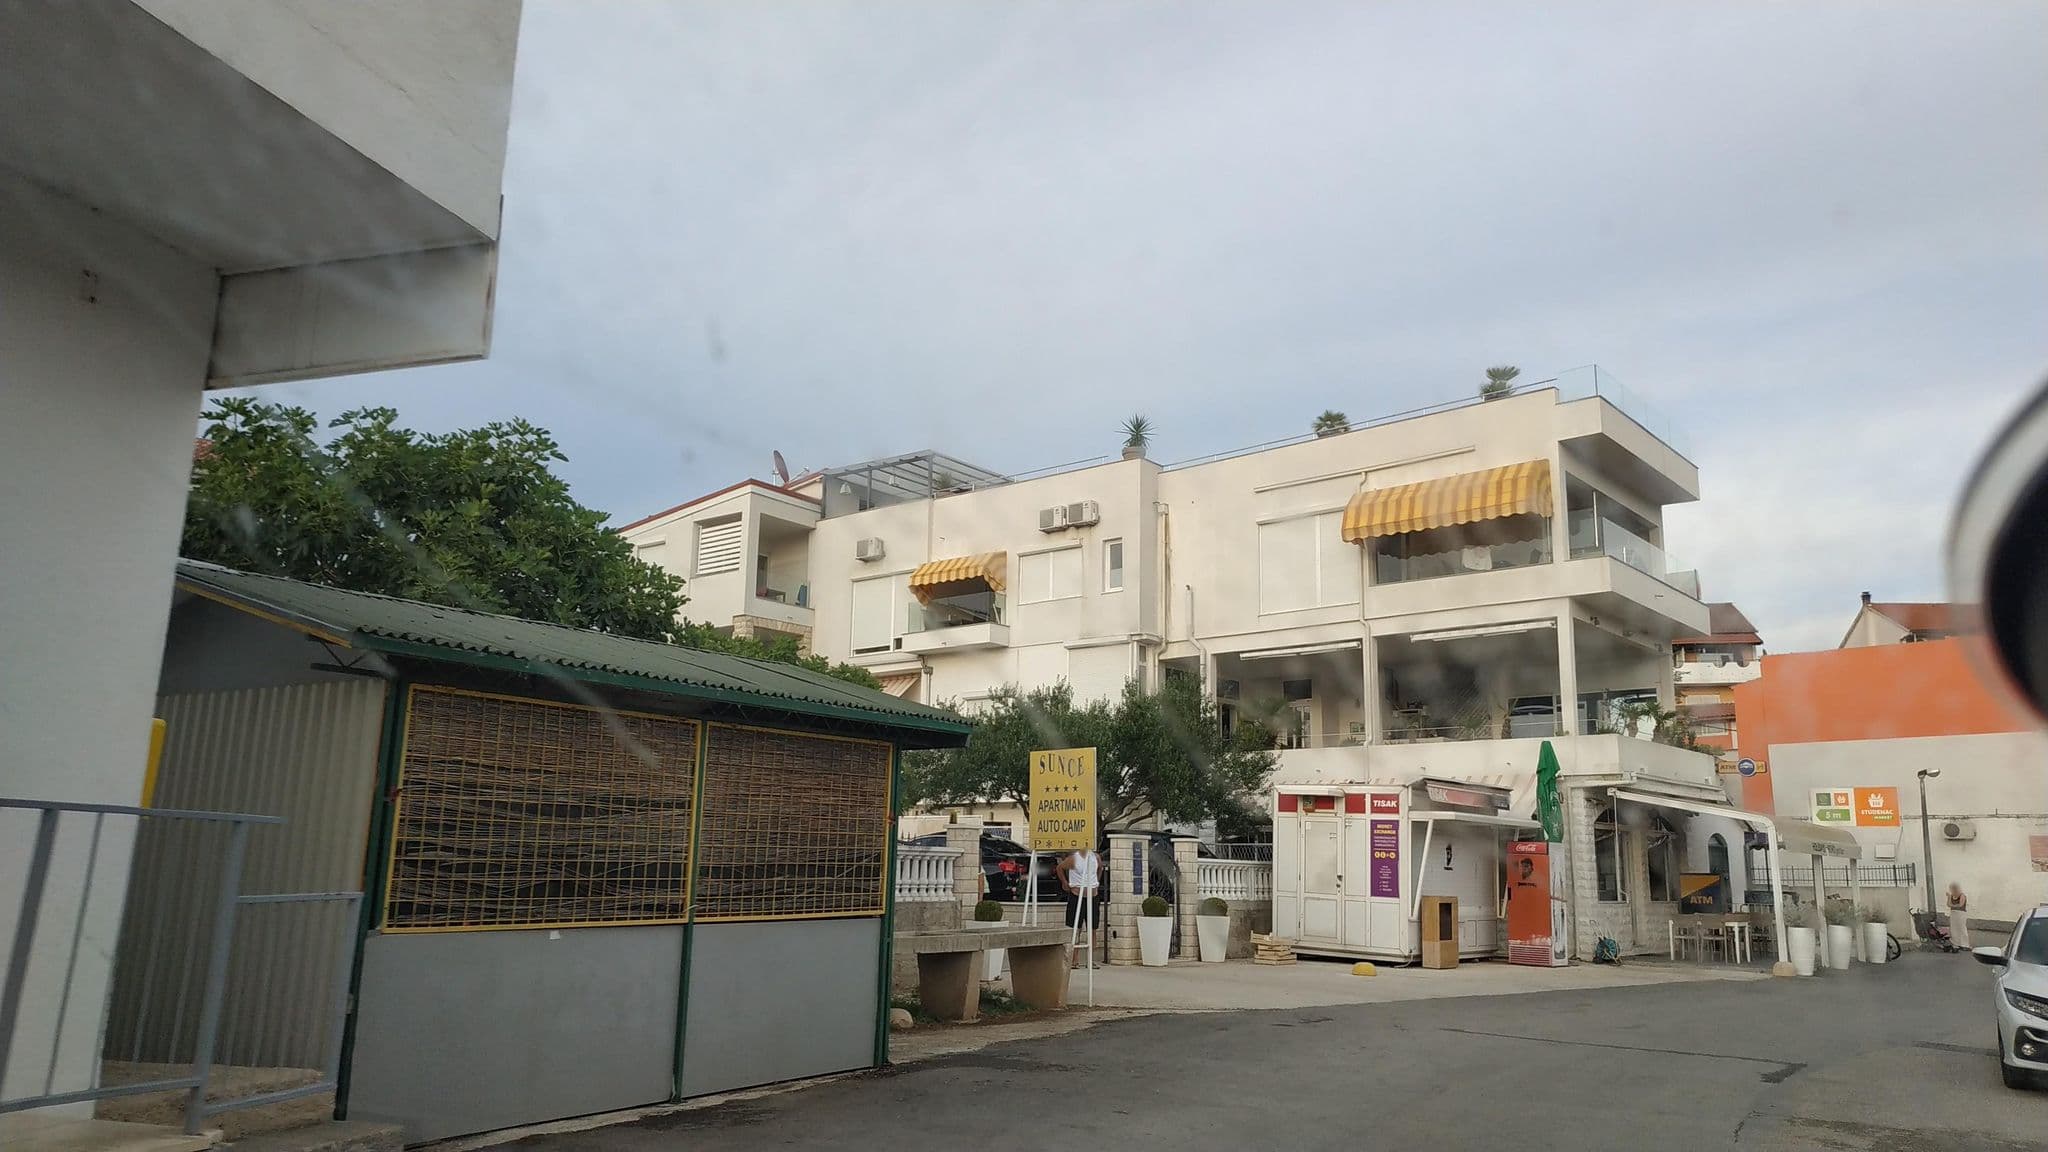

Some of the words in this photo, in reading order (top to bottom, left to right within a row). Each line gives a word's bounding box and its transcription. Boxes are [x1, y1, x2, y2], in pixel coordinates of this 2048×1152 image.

[1040, 753, 1084, 777] SUNCE
[1038, 799, 1085, 811] APARTMANI
[1373, 800, 1397, 808] TISAK
[1825, 811, 1831, 819] 5
[1038, 820, 1059, 832] AUTO
[1062, 819, 1085, 832] CAMP
[1690, 896, 1713, 905] ATM
